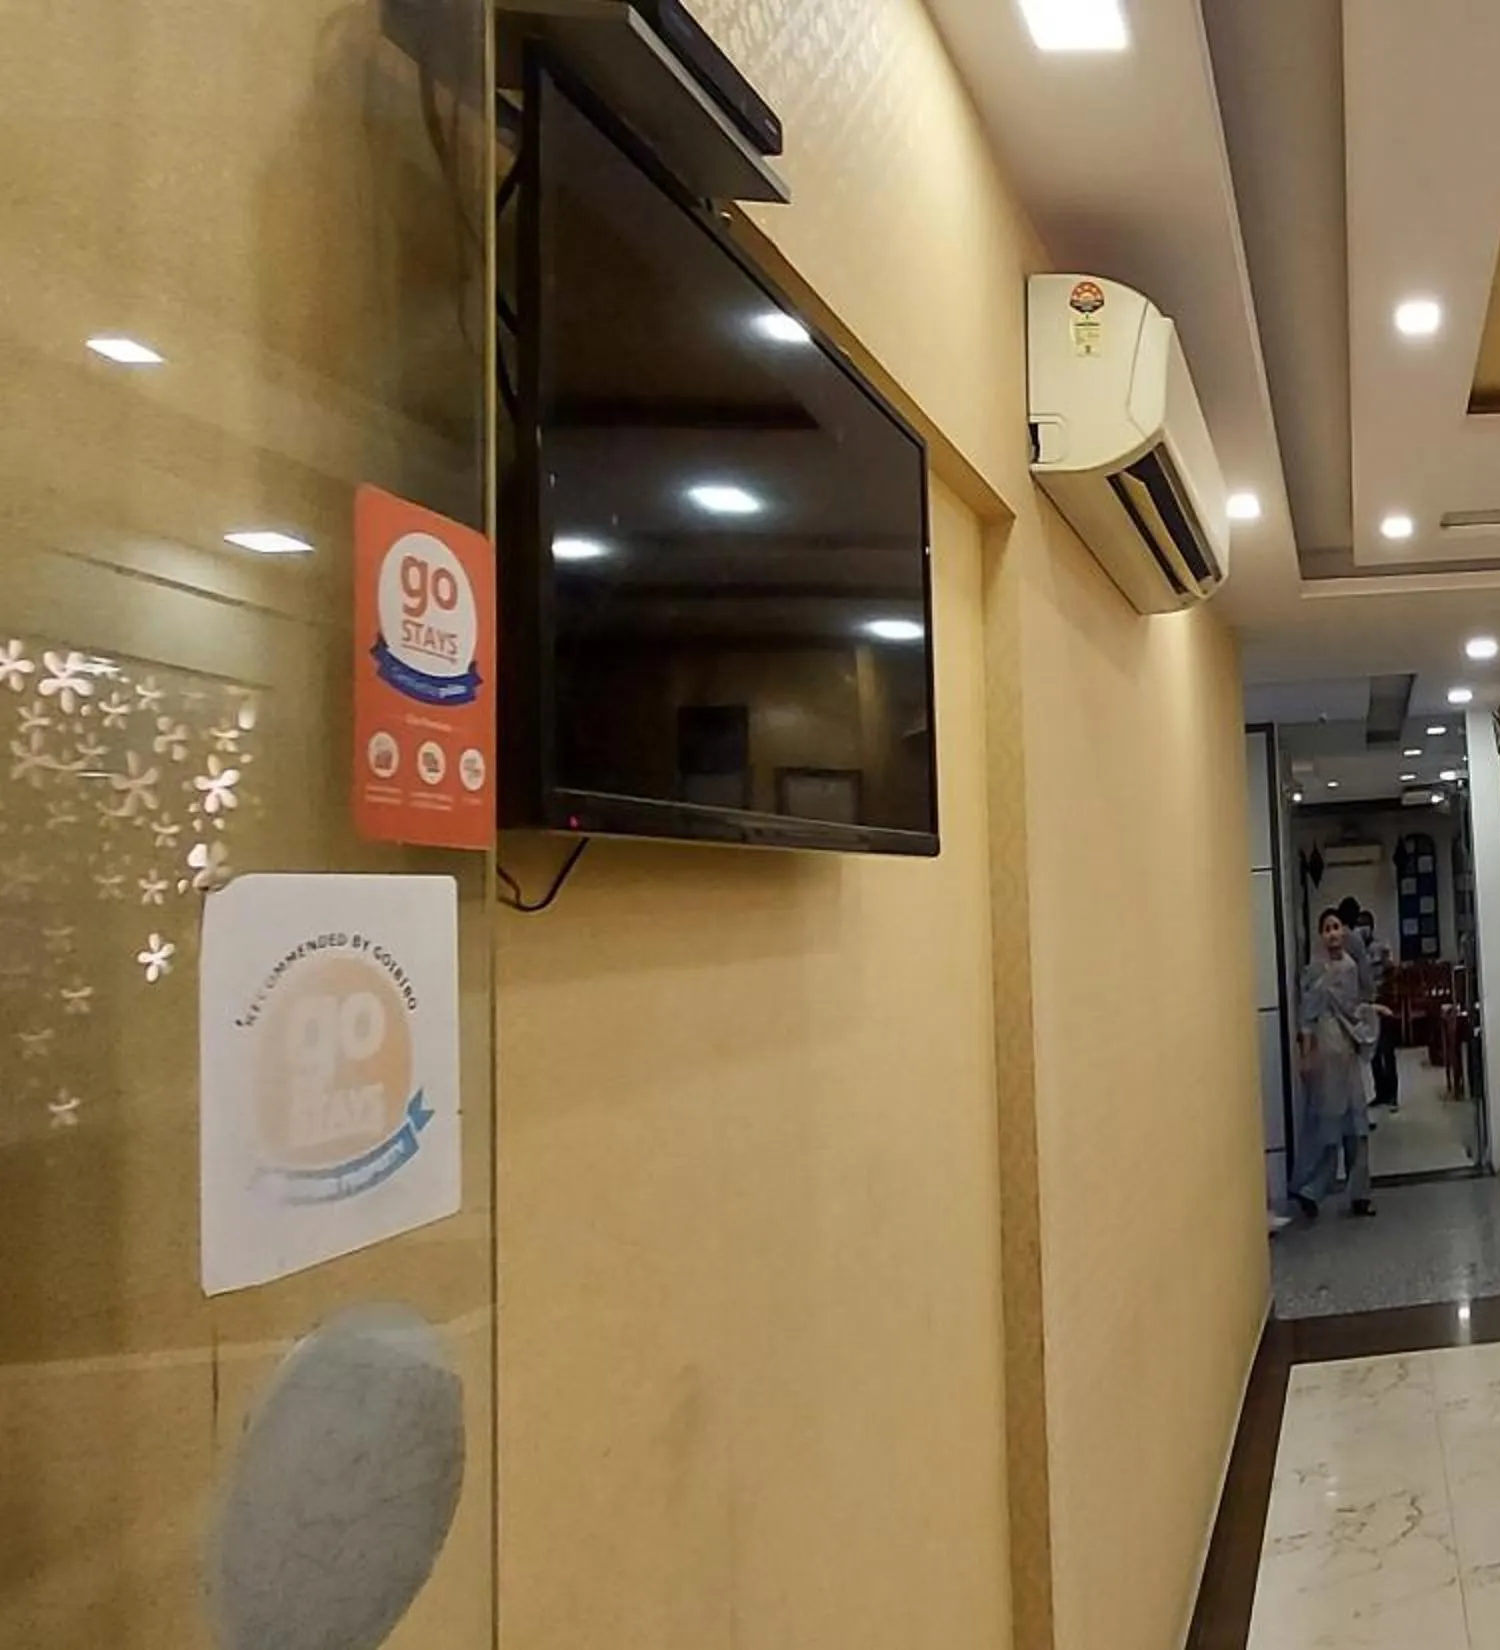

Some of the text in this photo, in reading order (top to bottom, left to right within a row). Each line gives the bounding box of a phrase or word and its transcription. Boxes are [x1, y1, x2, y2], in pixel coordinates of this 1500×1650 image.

[401, 556, 458, 617] go
[402, 619, 458, 655] STAYS
[352, 934, 370, 951] BY
[285, 991, 387, 1078] go
